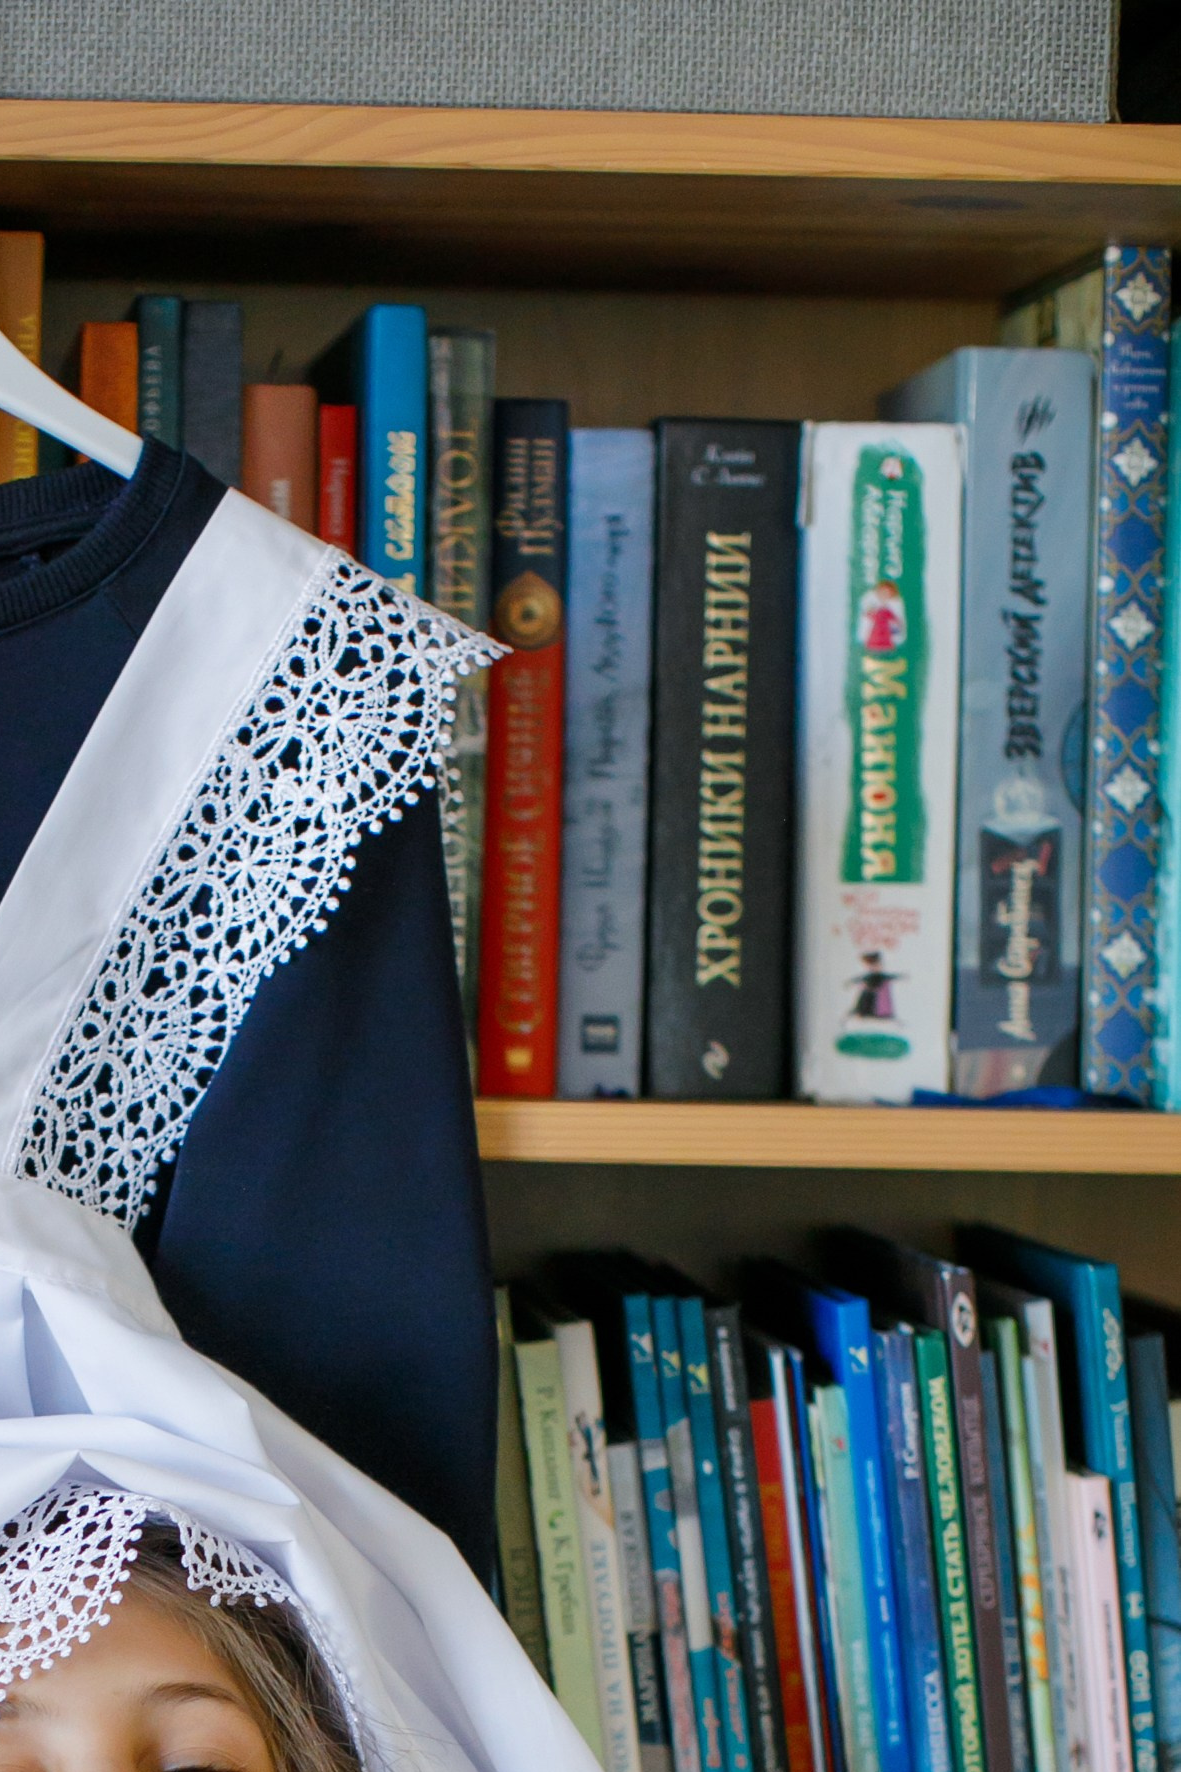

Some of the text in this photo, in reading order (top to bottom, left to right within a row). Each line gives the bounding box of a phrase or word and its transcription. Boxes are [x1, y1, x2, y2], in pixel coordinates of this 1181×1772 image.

[702, 530, 752, 739] НАРНИИ
[999, 451, 1048, 760] ЗВЕРСКИЙ ДЕТЕКТИВ
[860, 656, 908, 880] Манюня
[695, 749, 746, 987] ХРОНИКИ
[929, 1376, 956, 1520] ЧЕЛОВЕКОМ
[591, 1538, 620, 1666] ПРОГУЛКЕ
[943, 1522, 965, 1598] СТАТЬ
[950, 1602, 973, 1681] ХОТЕЛ
